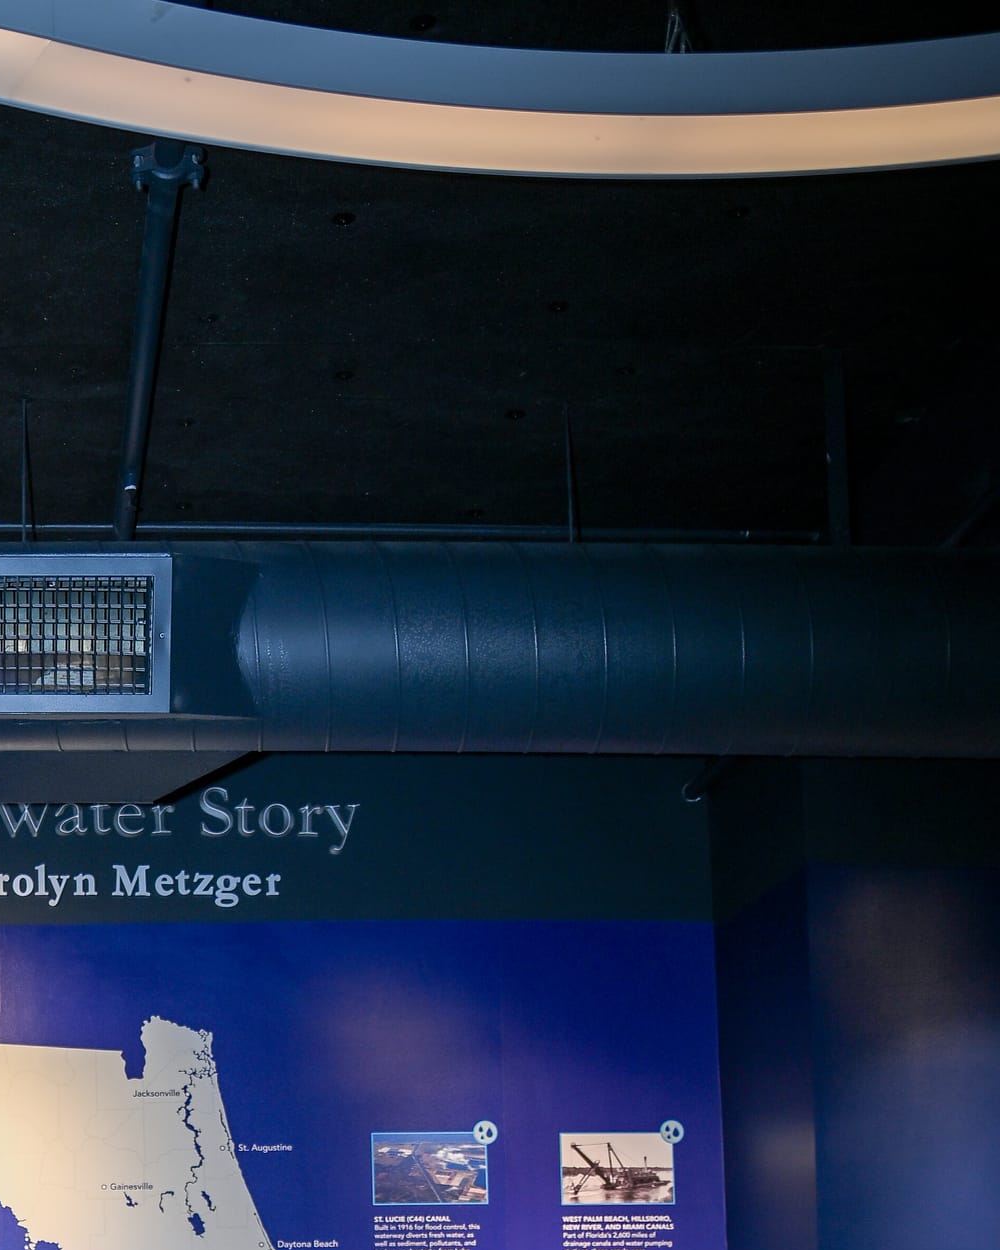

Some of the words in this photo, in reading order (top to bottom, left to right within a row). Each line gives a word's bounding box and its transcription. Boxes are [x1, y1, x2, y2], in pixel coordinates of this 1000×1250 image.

[199, 789, 361, 853] Story
[112, 865, 281, 905] Metzger
[251, 1144, 292, 1153] Augustine
[277, 1241, 312, 1249] Daytona
